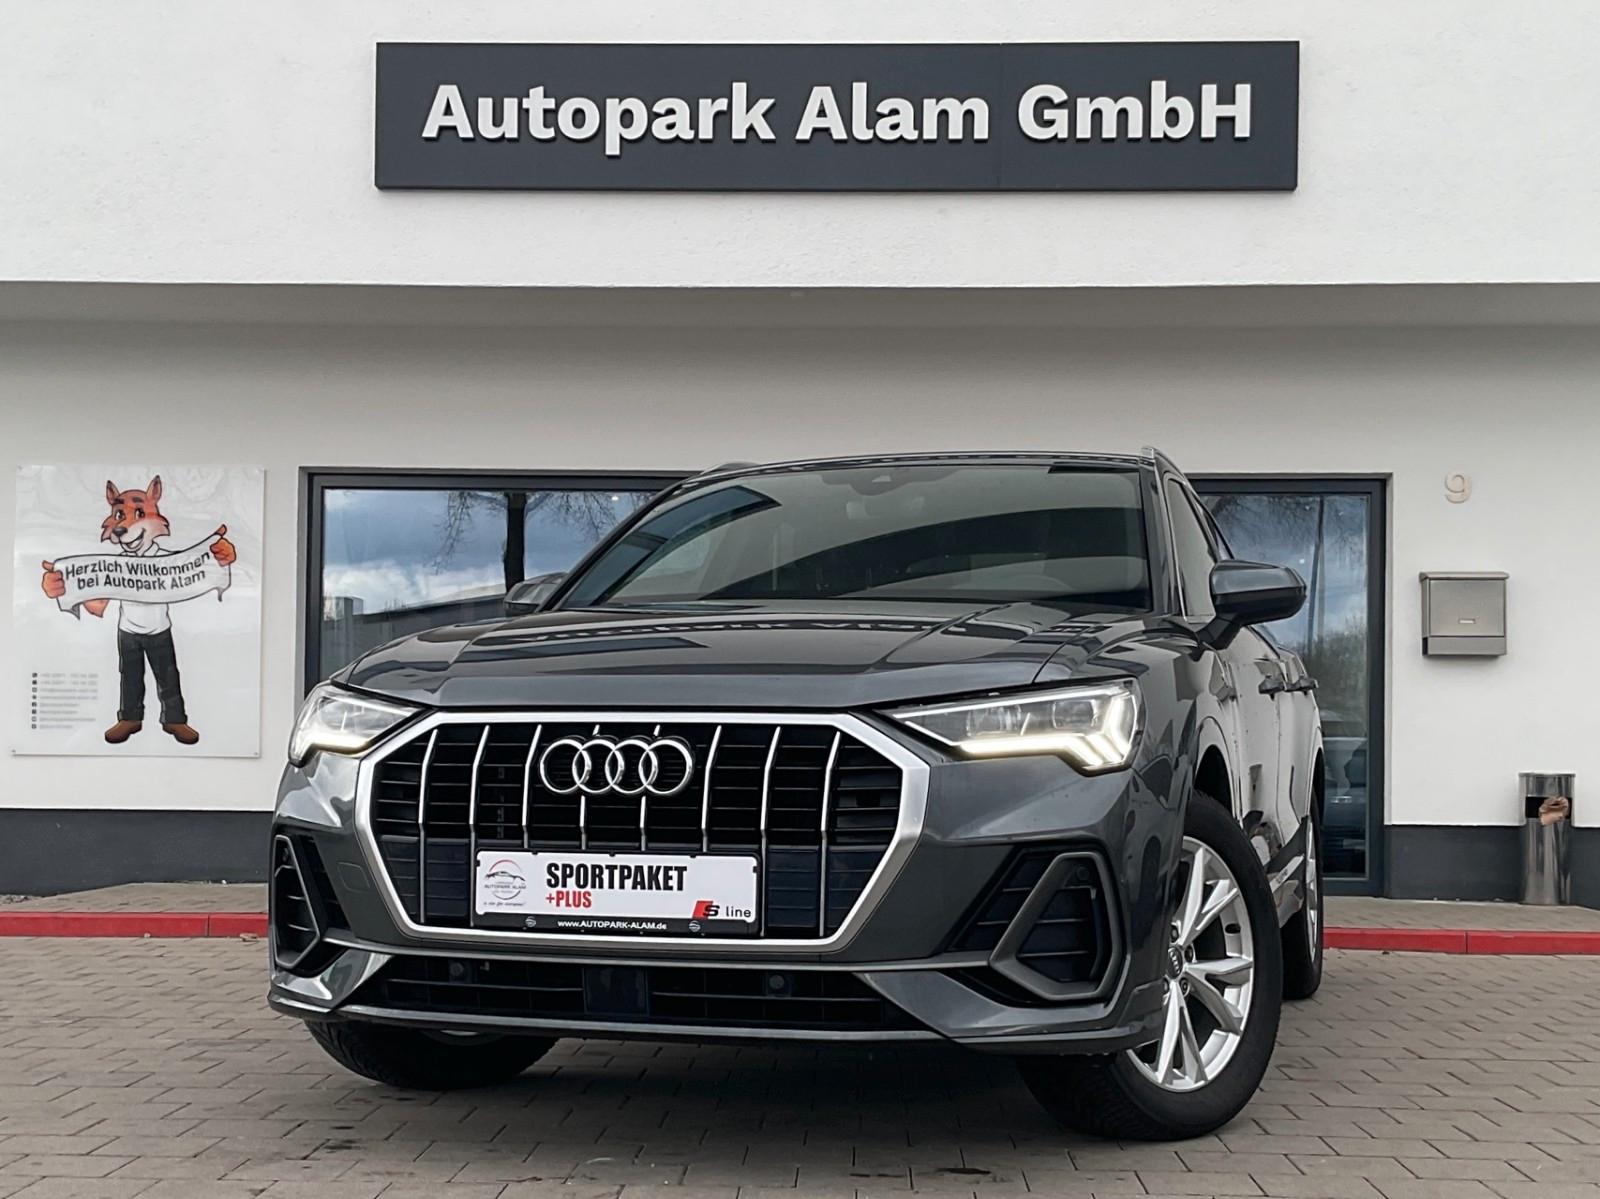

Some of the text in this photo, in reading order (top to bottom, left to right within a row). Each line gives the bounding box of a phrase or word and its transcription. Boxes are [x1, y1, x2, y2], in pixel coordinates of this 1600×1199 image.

[421, 80, 1252, 157] Autopark Alam GmbH
[1444, 472, 1472, 504] 9
[65, 552, 211, 580] Herzlich Willkommen
[77, 569, 206, 591] bei Autopark Alam
[546, 862, 688, 892] SPORTPAKET
[546, 890, 592, 908] +PLUS
[726, 906, 752, 918] line
[557, 920, 667, 931] www.AUTOPARK-ALAM.de
